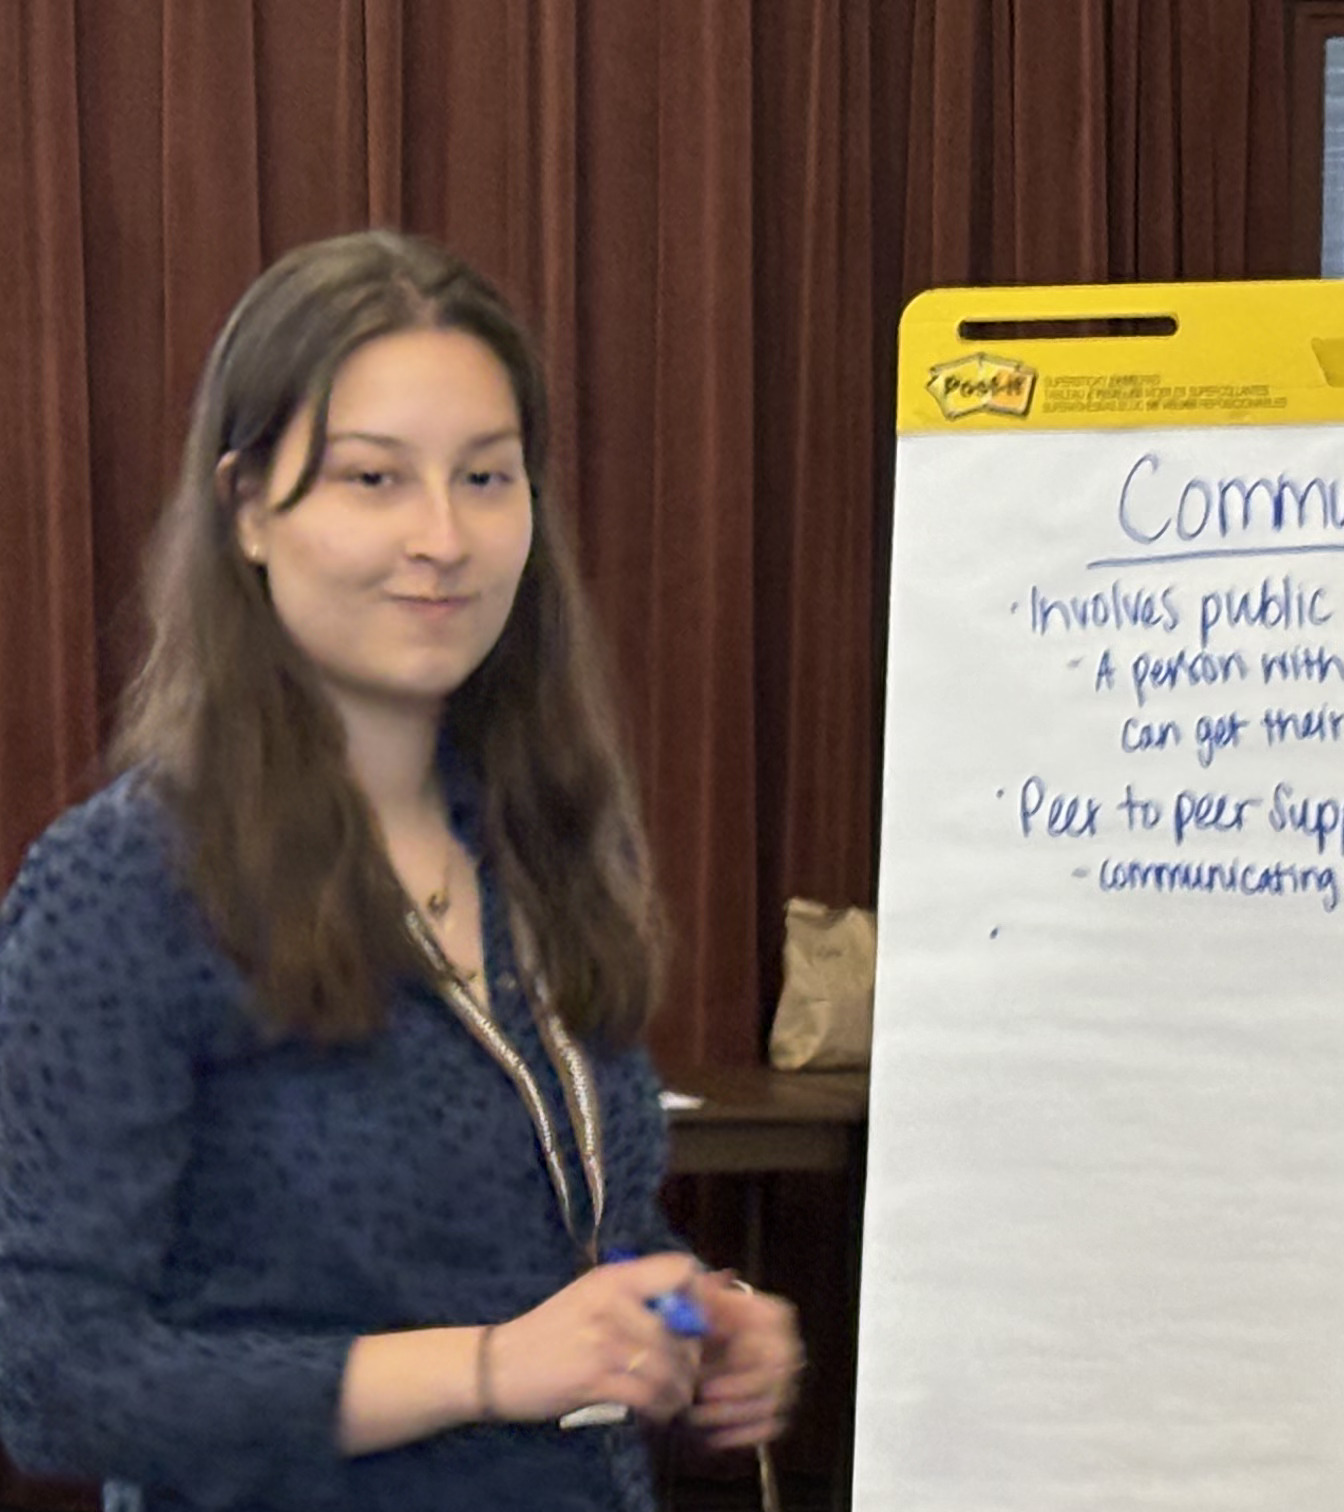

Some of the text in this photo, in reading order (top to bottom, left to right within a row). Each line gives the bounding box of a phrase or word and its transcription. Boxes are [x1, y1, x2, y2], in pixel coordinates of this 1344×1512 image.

[1031, 579, 1180, 636] Involves
[1200, 574, 1333, 649] public
[1095, 648, 1117, 693] A
[1131, 648, 1250, 708] person
[1119, 715, 1183, 754] can
[1195, 710, 1252, 769] get
[1018, 776, 1104, 840] Peer
[1119, 784, 1164, 830] to
[1172, 786, 1260, 846] peer
